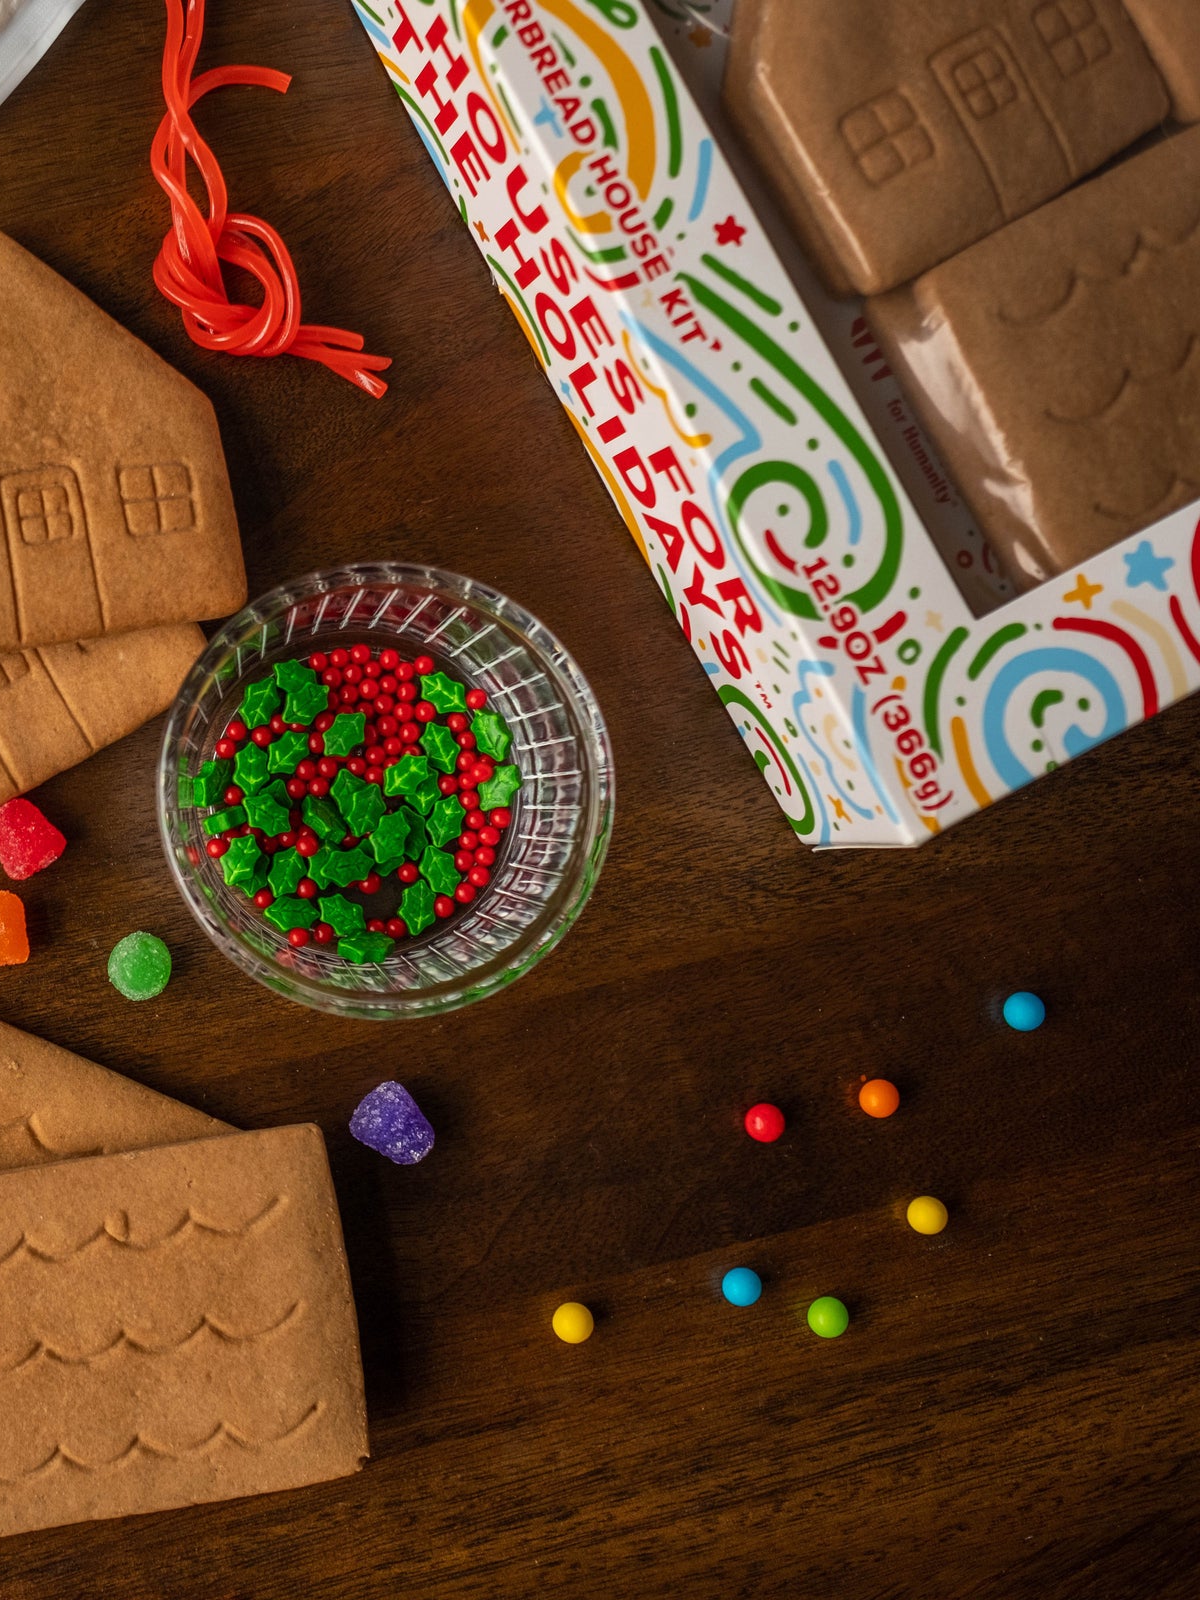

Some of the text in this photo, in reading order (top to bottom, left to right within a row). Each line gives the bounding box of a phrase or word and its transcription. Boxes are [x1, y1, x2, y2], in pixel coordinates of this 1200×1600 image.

[392, 0, 491, 198] THE
[500, 0, 707, 343] RBREAD HOUSE KIT
[425, 14, 765, 637] HOUSES FOR
[887, 398, 951, 504] for Humanity
[872, 694, 953, 811] (366g)
